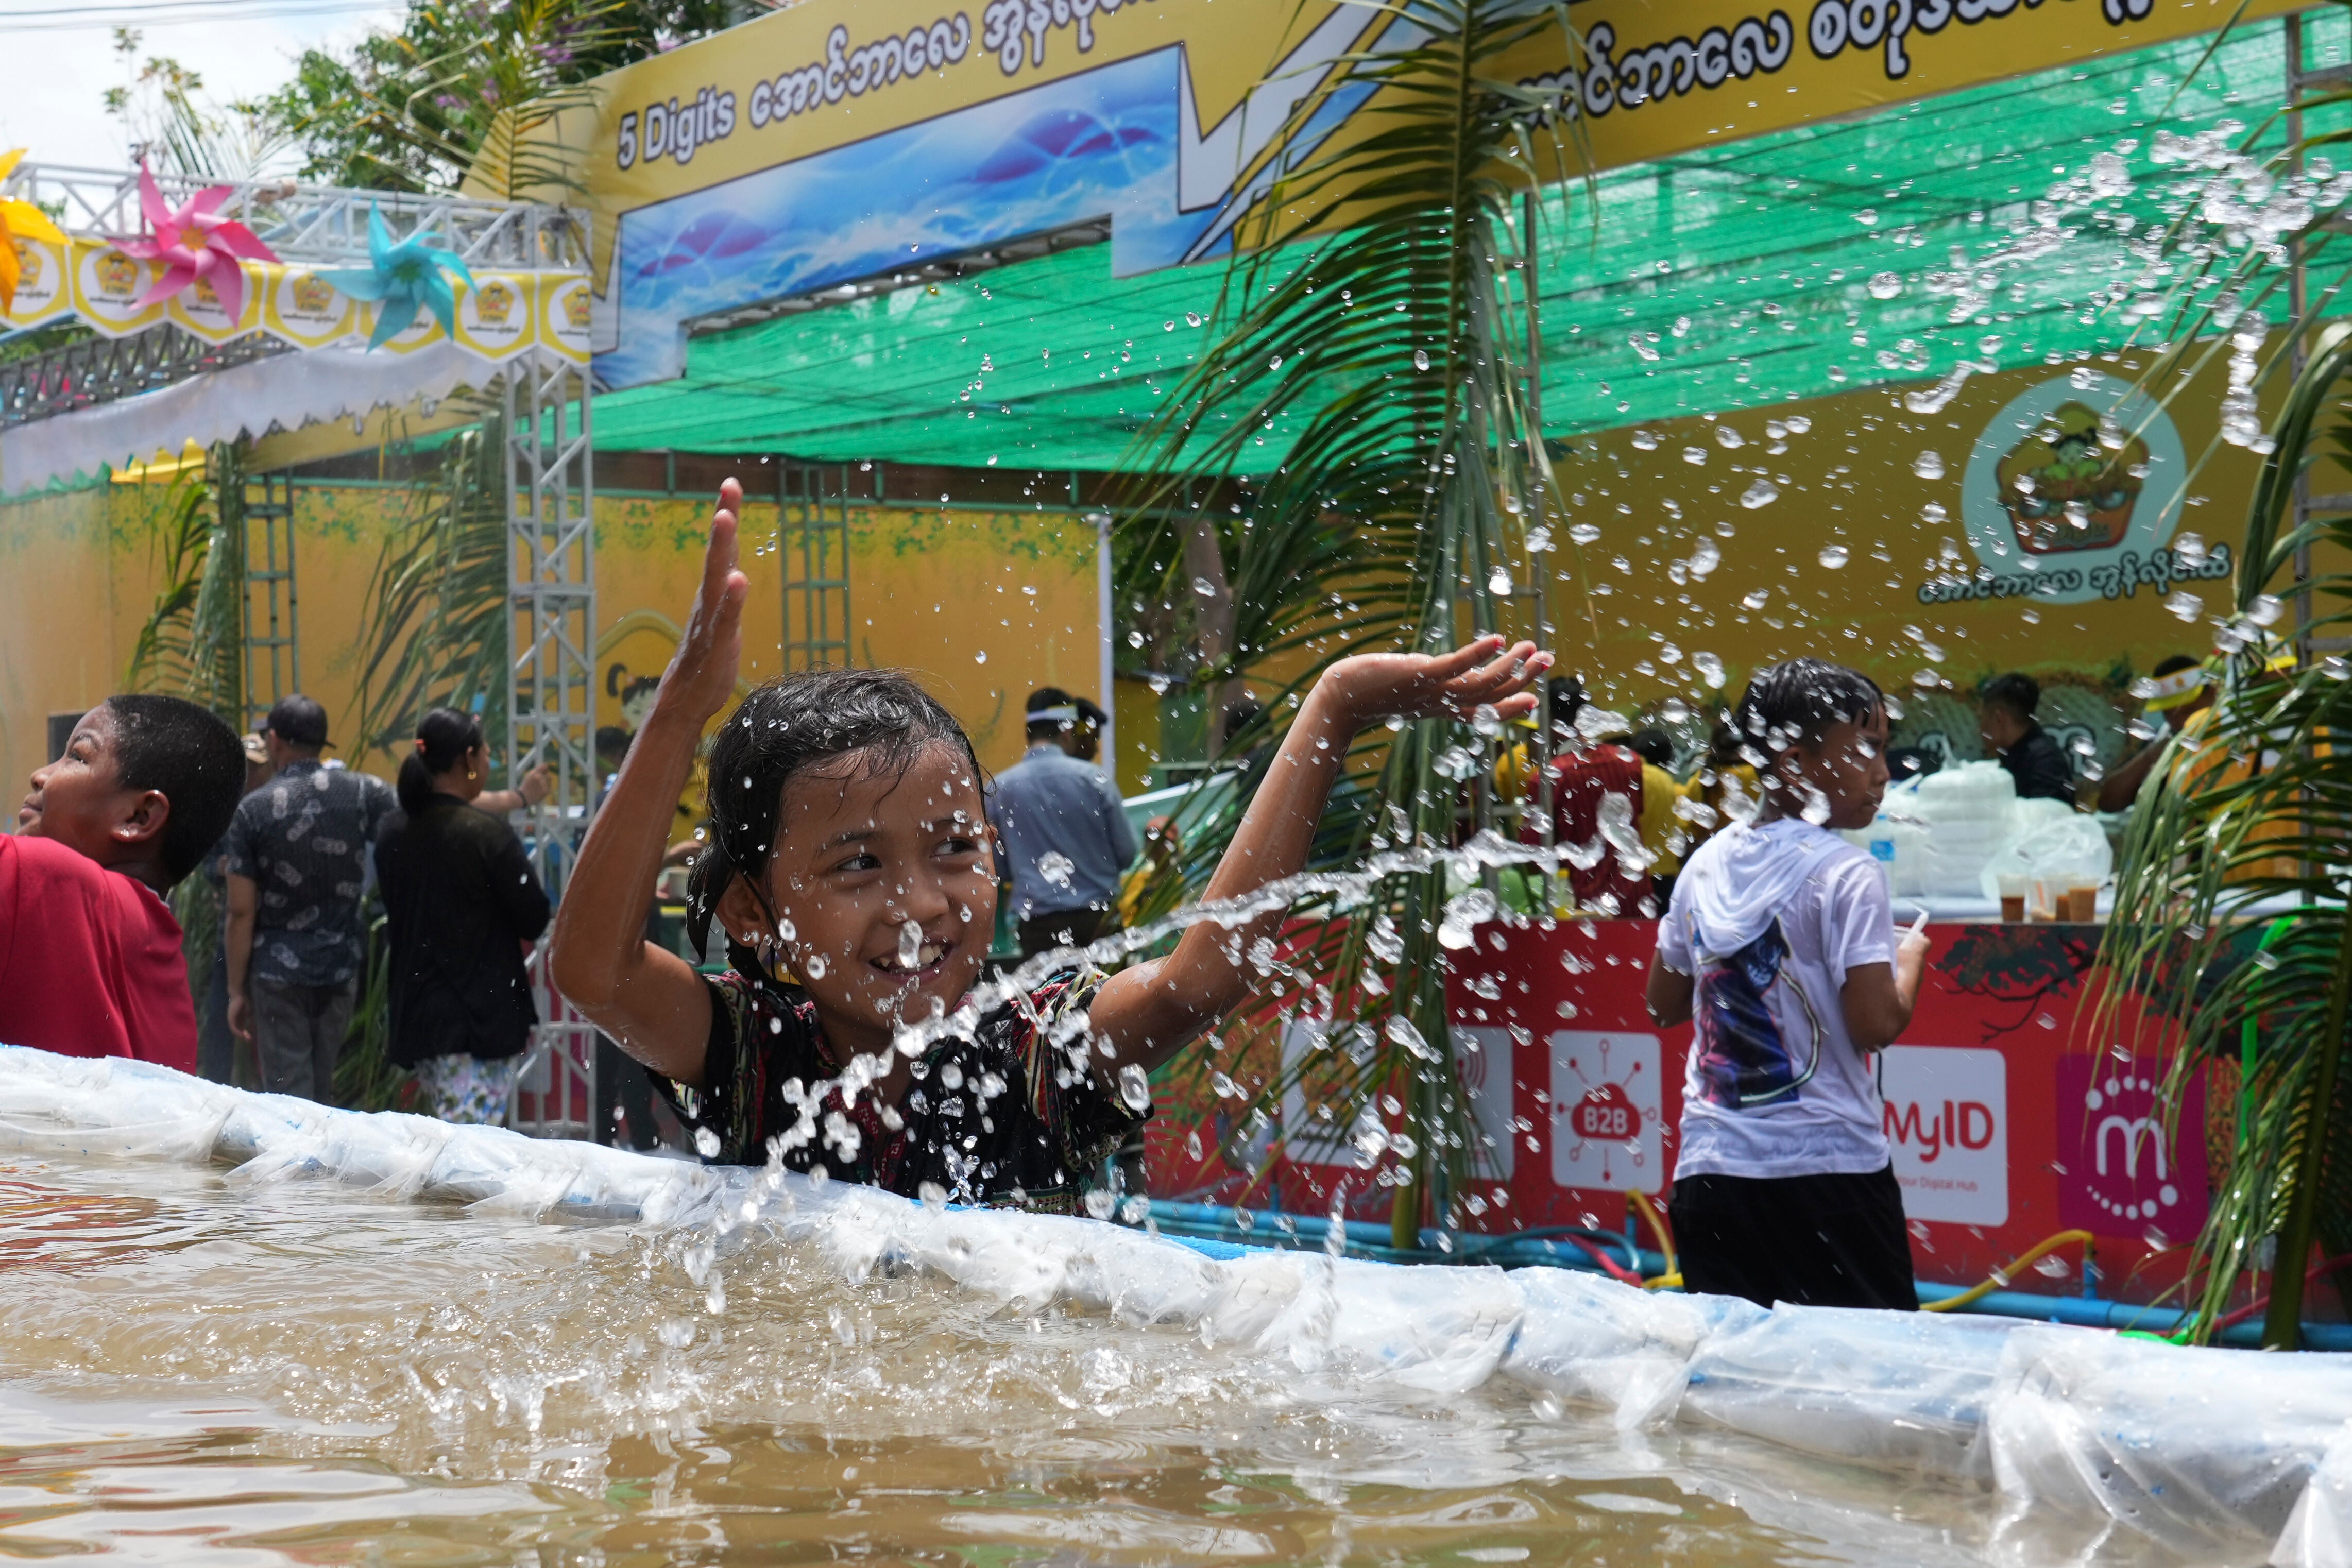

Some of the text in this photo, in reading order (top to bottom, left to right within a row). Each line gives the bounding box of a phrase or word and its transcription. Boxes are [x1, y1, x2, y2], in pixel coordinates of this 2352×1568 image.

[618, 110, 638, 171] 5
[643, 85, 736, 165] Digits
[1583, 1105, 1628, 1135] B2B
[1883, 1099, 1995, 1163] MyID
